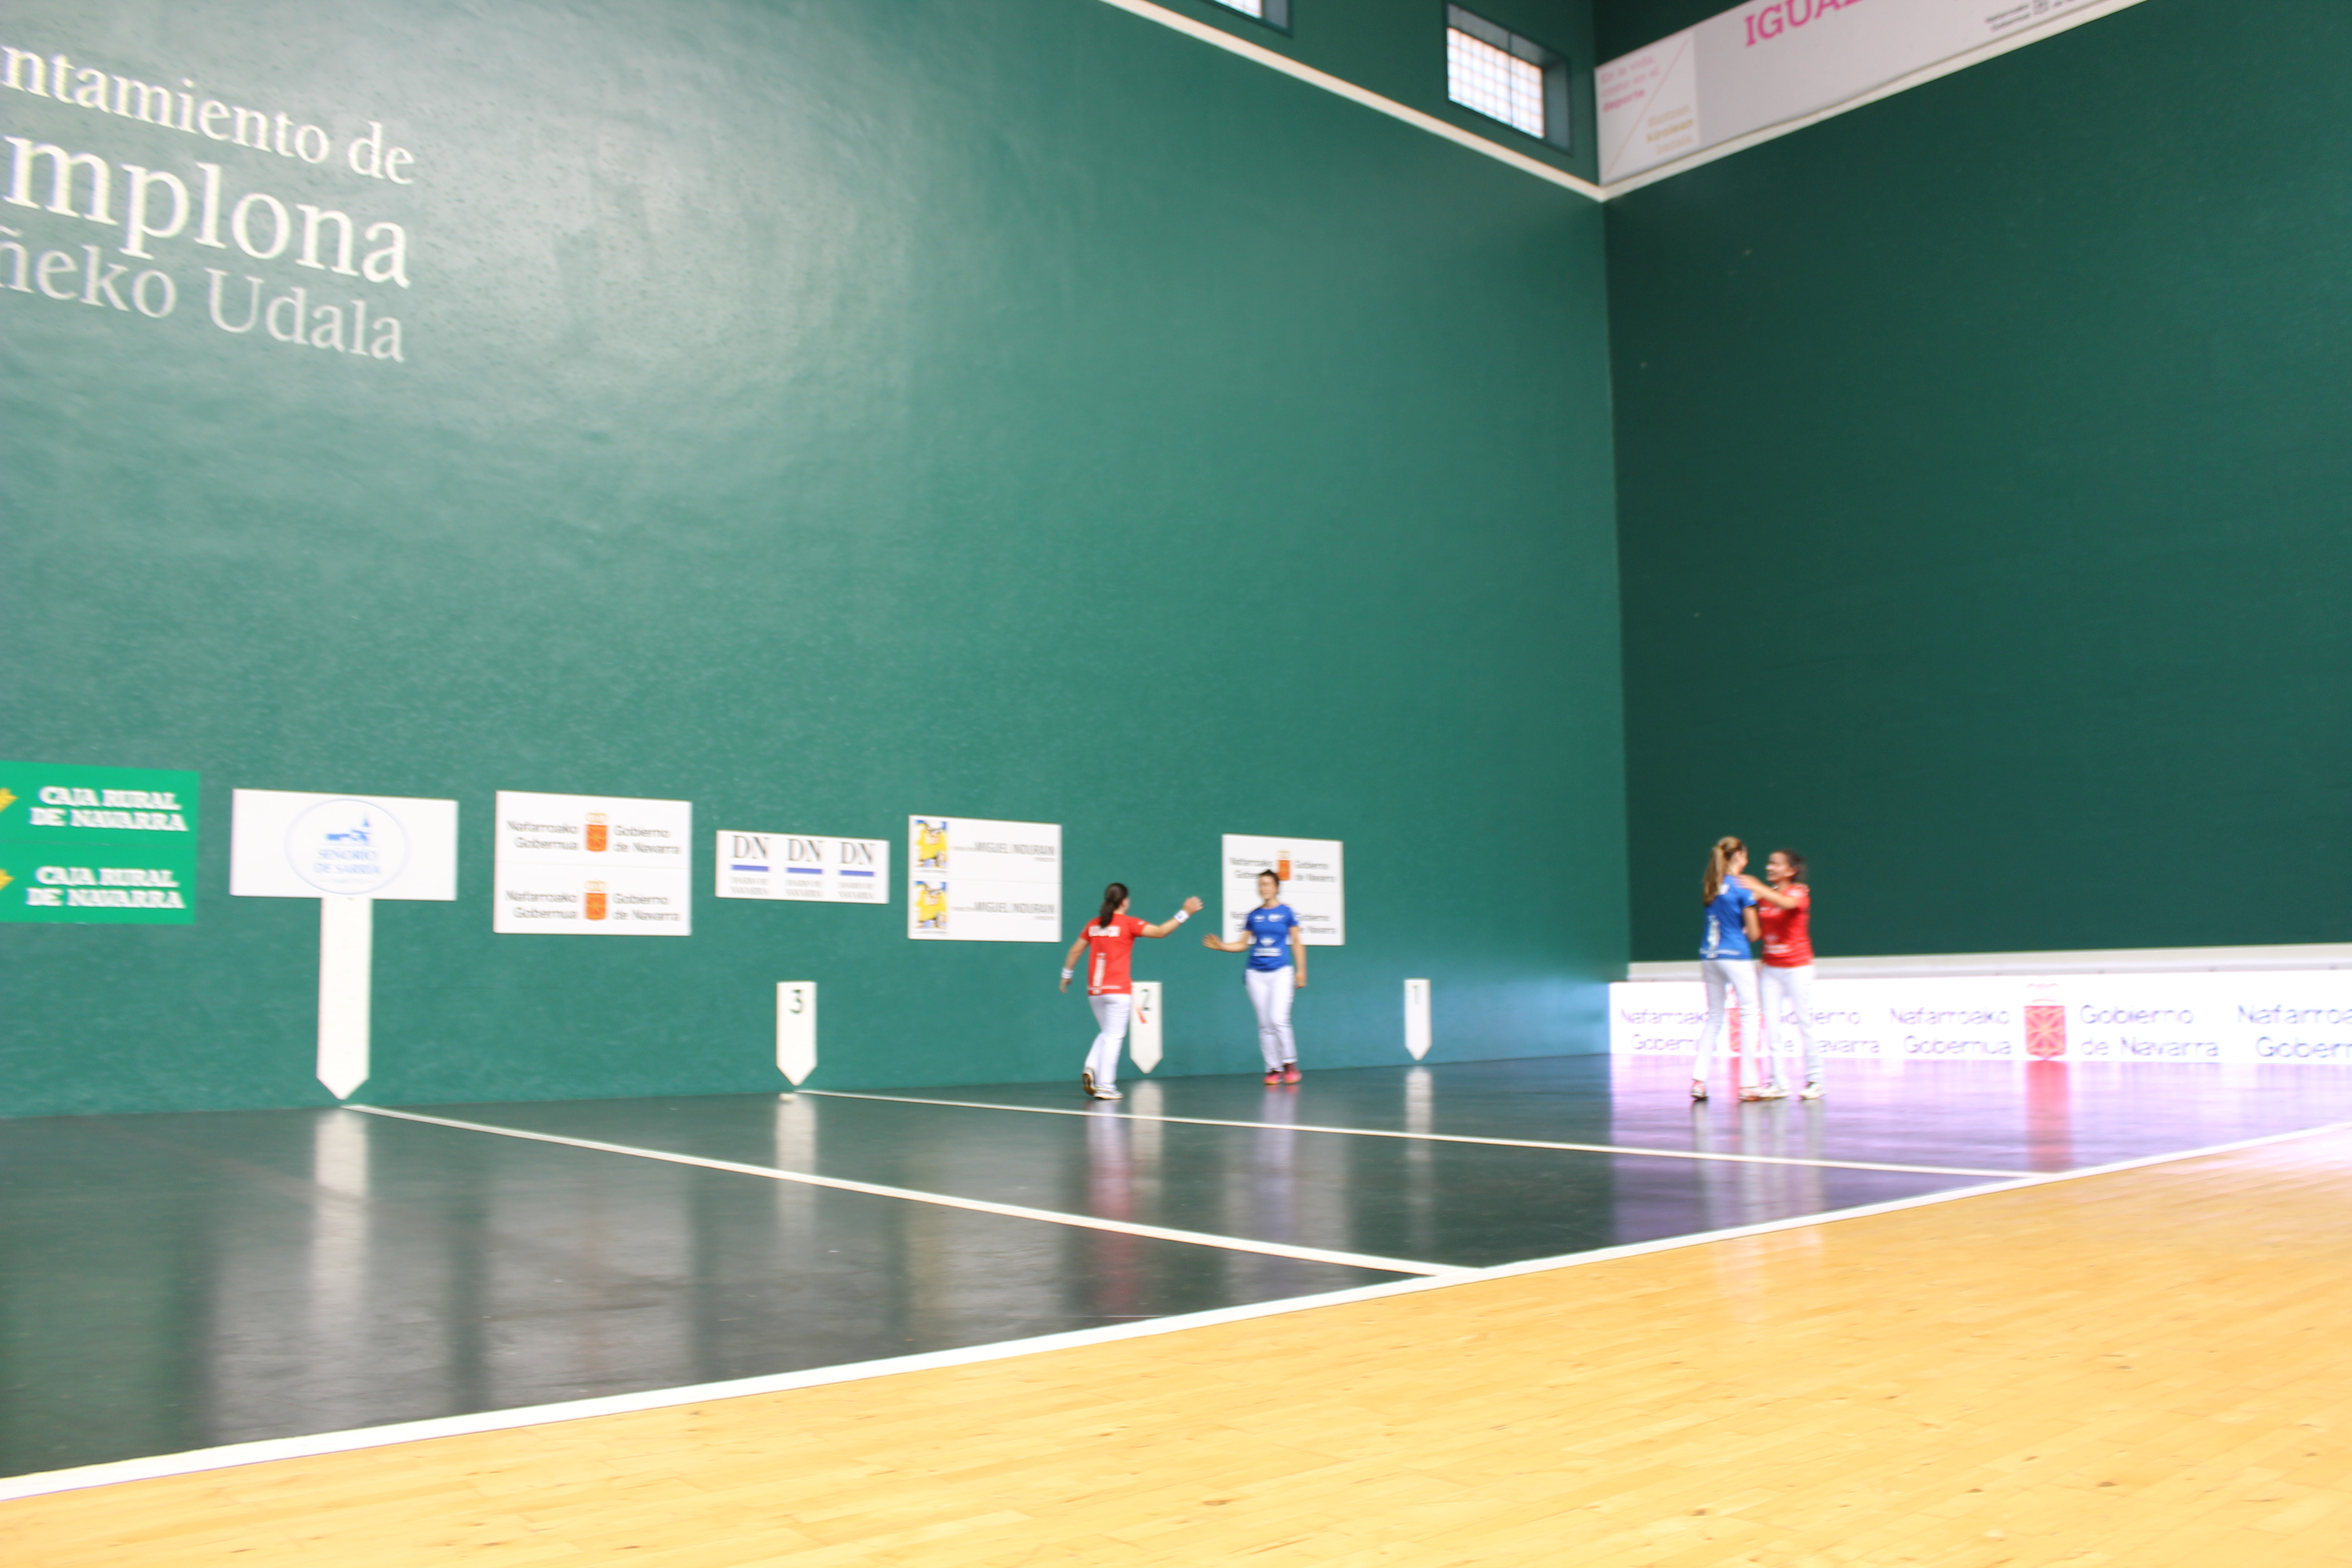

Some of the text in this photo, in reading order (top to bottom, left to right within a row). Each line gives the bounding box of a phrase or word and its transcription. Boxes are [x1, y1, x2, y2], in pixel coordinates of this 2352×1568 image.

[1, 45, 415, 184] ntamiento de
[3, 135, 411, 289] mplona
[204, 267, 405, 363] Udala
[39, 785, 182, 810] CAJA RURAL
[29, 807, 189, 832] DE NAVARRA
[506, 820, 579, 834] Nafarroako
[613, 825, 671, 838] Gobierno
[514, 837, 578, 851] Gobernua
[613, 842, 681, 855] de Navarra
[731, 835, 770, 859] DN
[787, 838, 825, 862] DN
[840, 842, 877, 865] DN
[35, 866, 180, 888] CAJA RURAL
[26, 887, 186, 909] DE NAVARRA
[505, 890, 578, 903] Nafarroako
[612, 893, 670, 906] Gobierno
[513, 907, 578, 920] Gobernua
[612, 909, 681, 922] de Navarra
[789, 989, 804, 1014] 3
[1142, 988, 1151, 1011] 2
[1889, 1006, 2010, 1025] Nafarroako
[2079, 1004, 2195, 1024] Gobierno
[1816, 1039, 1882, 1054] avarra
[1904, 1035, 2012, 1055] Gobernua
[2080, 1036, 2220, 1057] de Navarra
